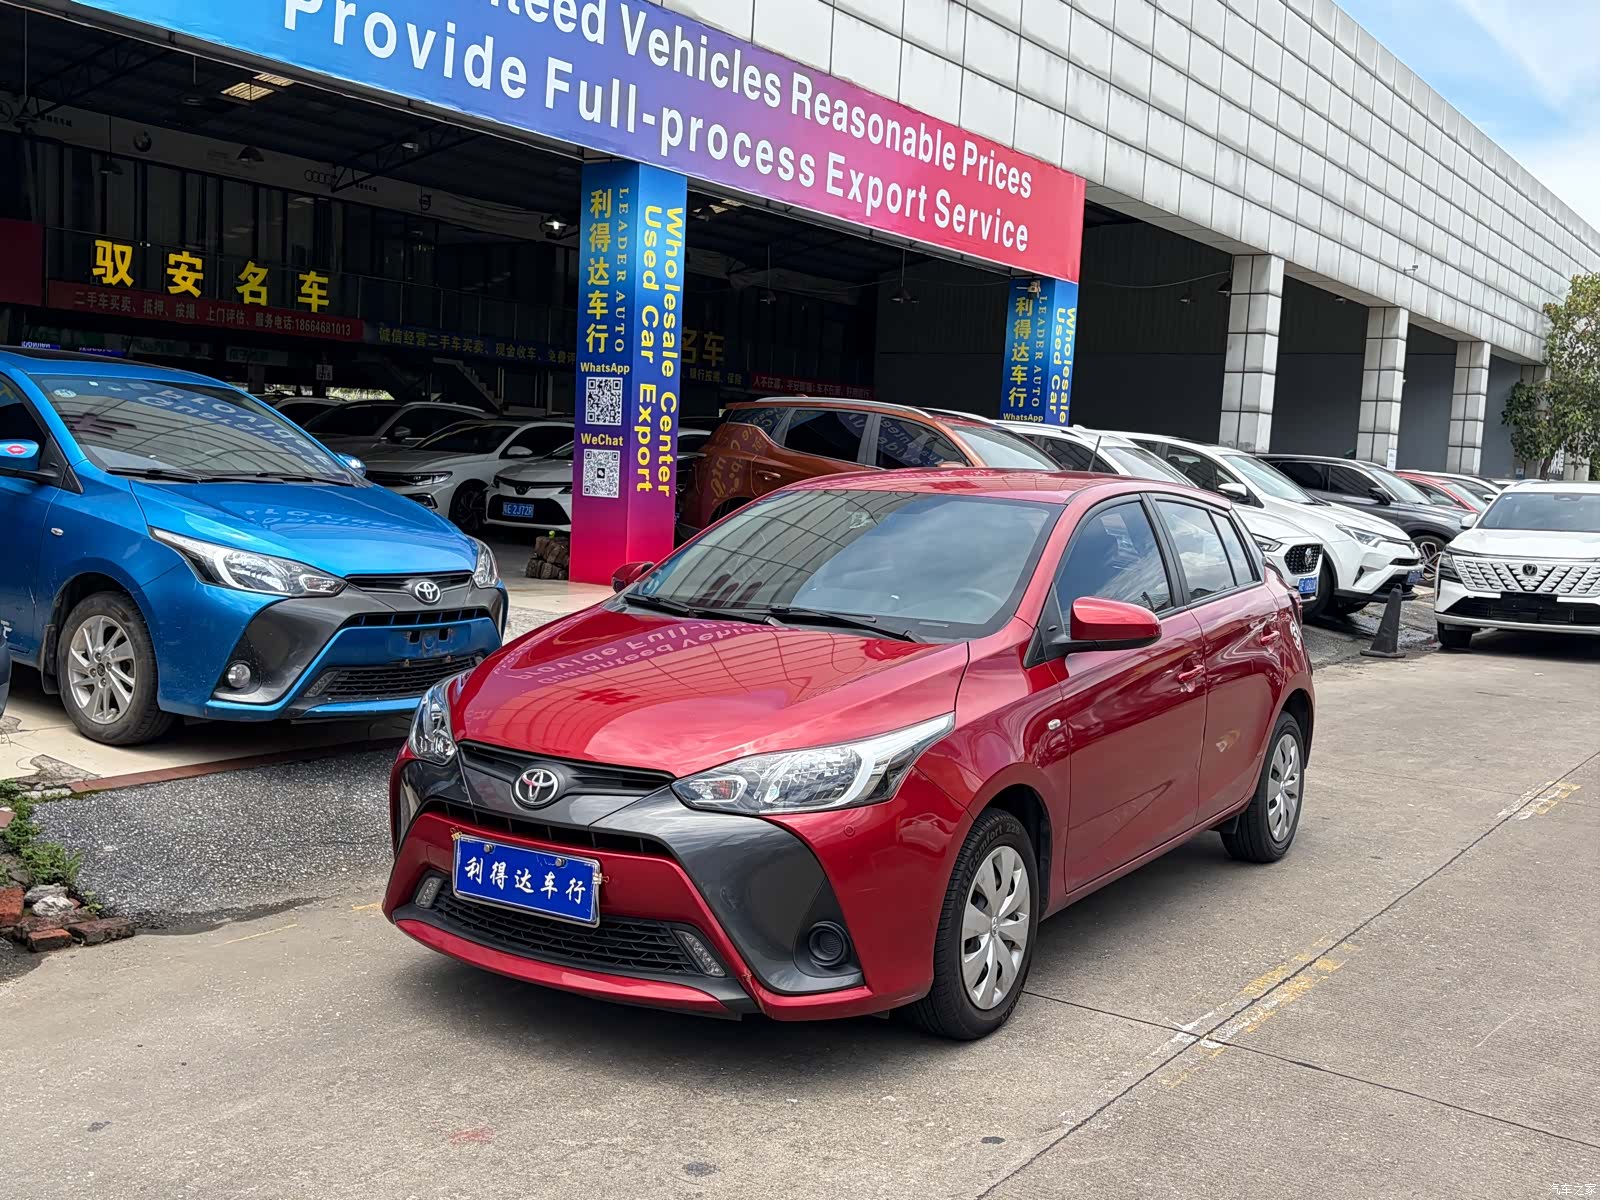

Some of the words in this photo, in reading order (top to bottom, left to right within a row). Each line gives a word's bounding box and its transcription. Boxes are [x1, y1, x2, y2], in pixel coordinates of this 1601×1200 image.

[284, 0, 527, 99] Provide
[545, 56, 815, 188] Full-process
[826, 151, 927, 223] Export
[934, 188, 1028, 252] Service
[620, 3, 781, 108] Vehicles
[791, 72, 956, 171] Reasonable
[962, 140, 1032, 199] Prices
[586, 188, 612, 353] 利得达车行
[617, 187, 629, 283] LEADER
[643, 205, 663, 291] Used
[91, 239, 331, 313] 驭安名车
[662, 207, 684, 378] Wholesale
[615, 291, 626, 352] AUTO
[641, 305, 659, 364] Car
[1008, 296, 1033, 408] 利得达车行
[1035, 295, 1048, 360] LEADER
[1053, 307, 1066, 365] Used
[580, 362, 630, 375] WhatsApp
[1031, 365, 1042, 407] AUTO
[1050, 374, 1060, 415] Car
[1059, 307, 1076, 424] Wholesale
[580, 432, 624, 447] WeChat
[634, 383, 657, 493] Export
[658, 391, 677, 498] Center
[1003, 412, 1044, 422] WhatsApp
[464, 856, 587, 905] 利得达车行
